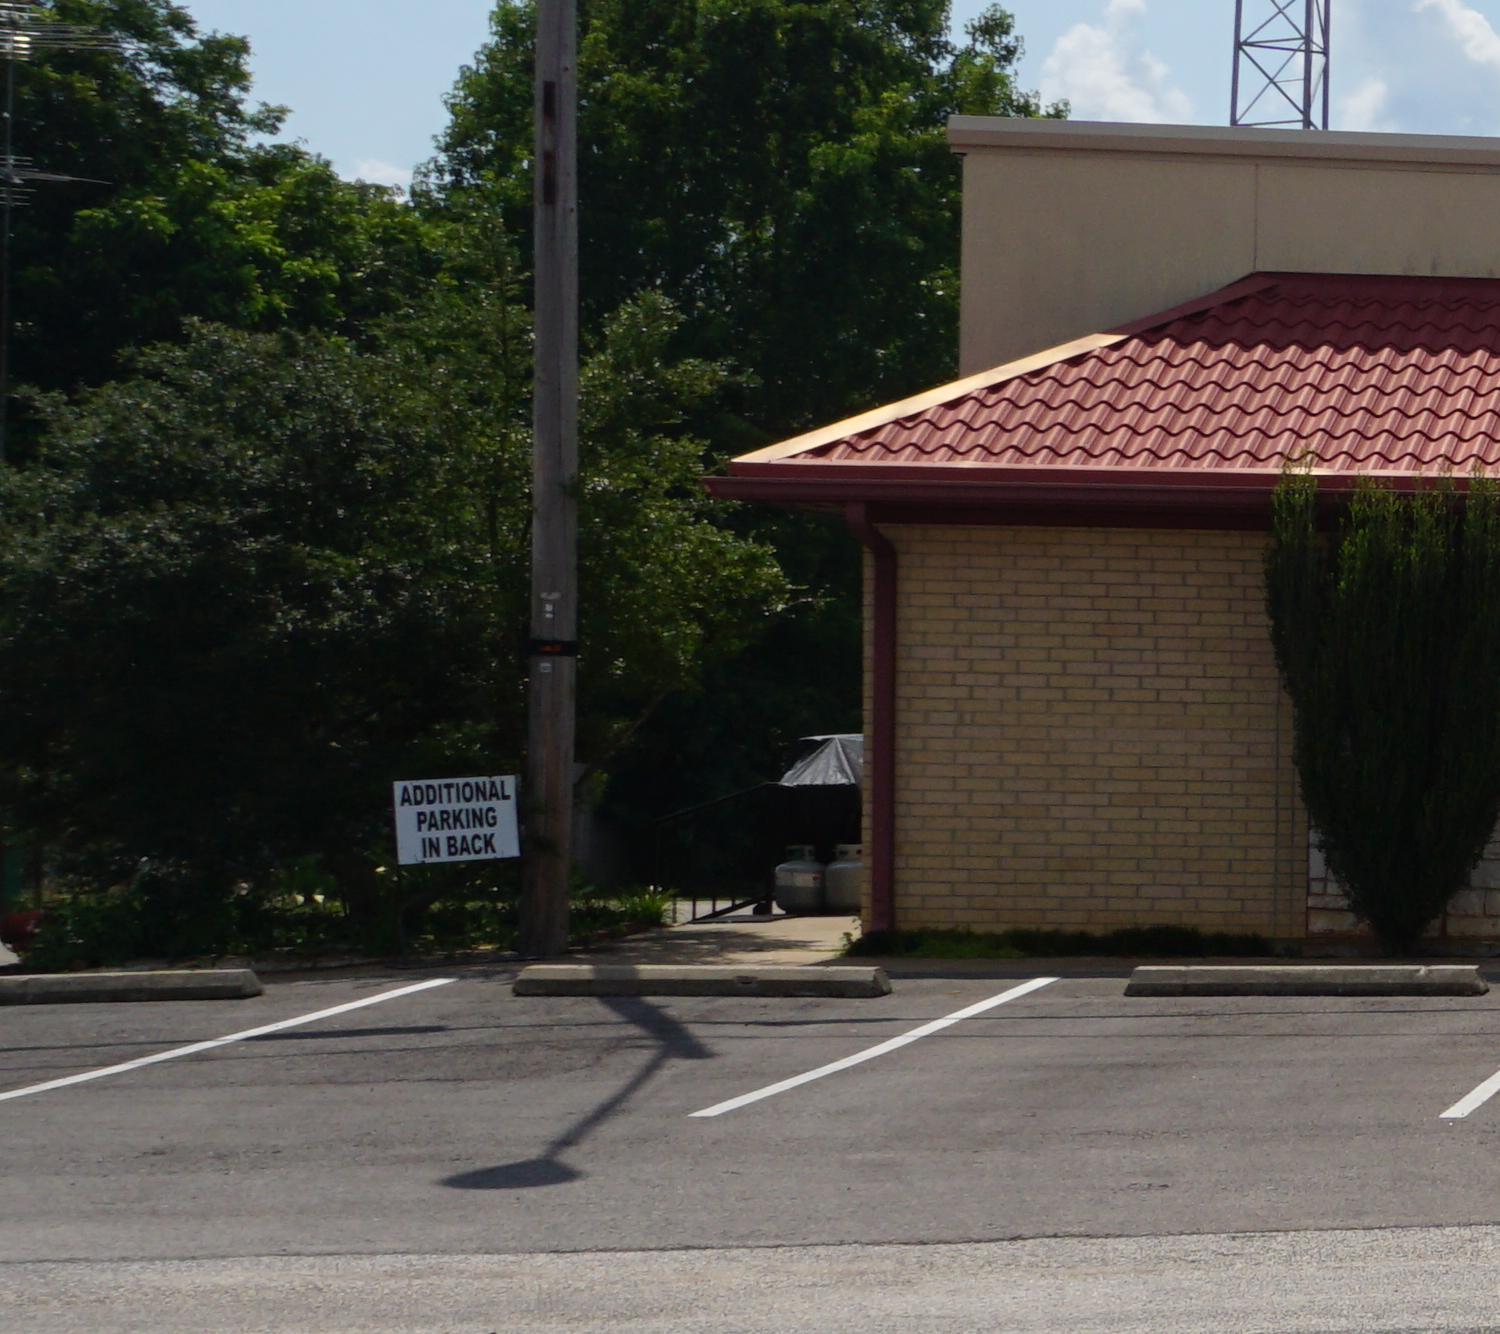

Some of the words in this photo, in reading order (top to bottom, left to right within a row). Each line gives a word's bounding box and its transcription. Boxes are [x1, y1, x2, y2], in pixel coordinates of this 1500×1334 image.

[400, 780, 511, 806] ADDITIONAL
[417, 807, 497, 832] PARKING
[421, 837, 441, 858] IN
[446, 832, 497, 856] BACK
